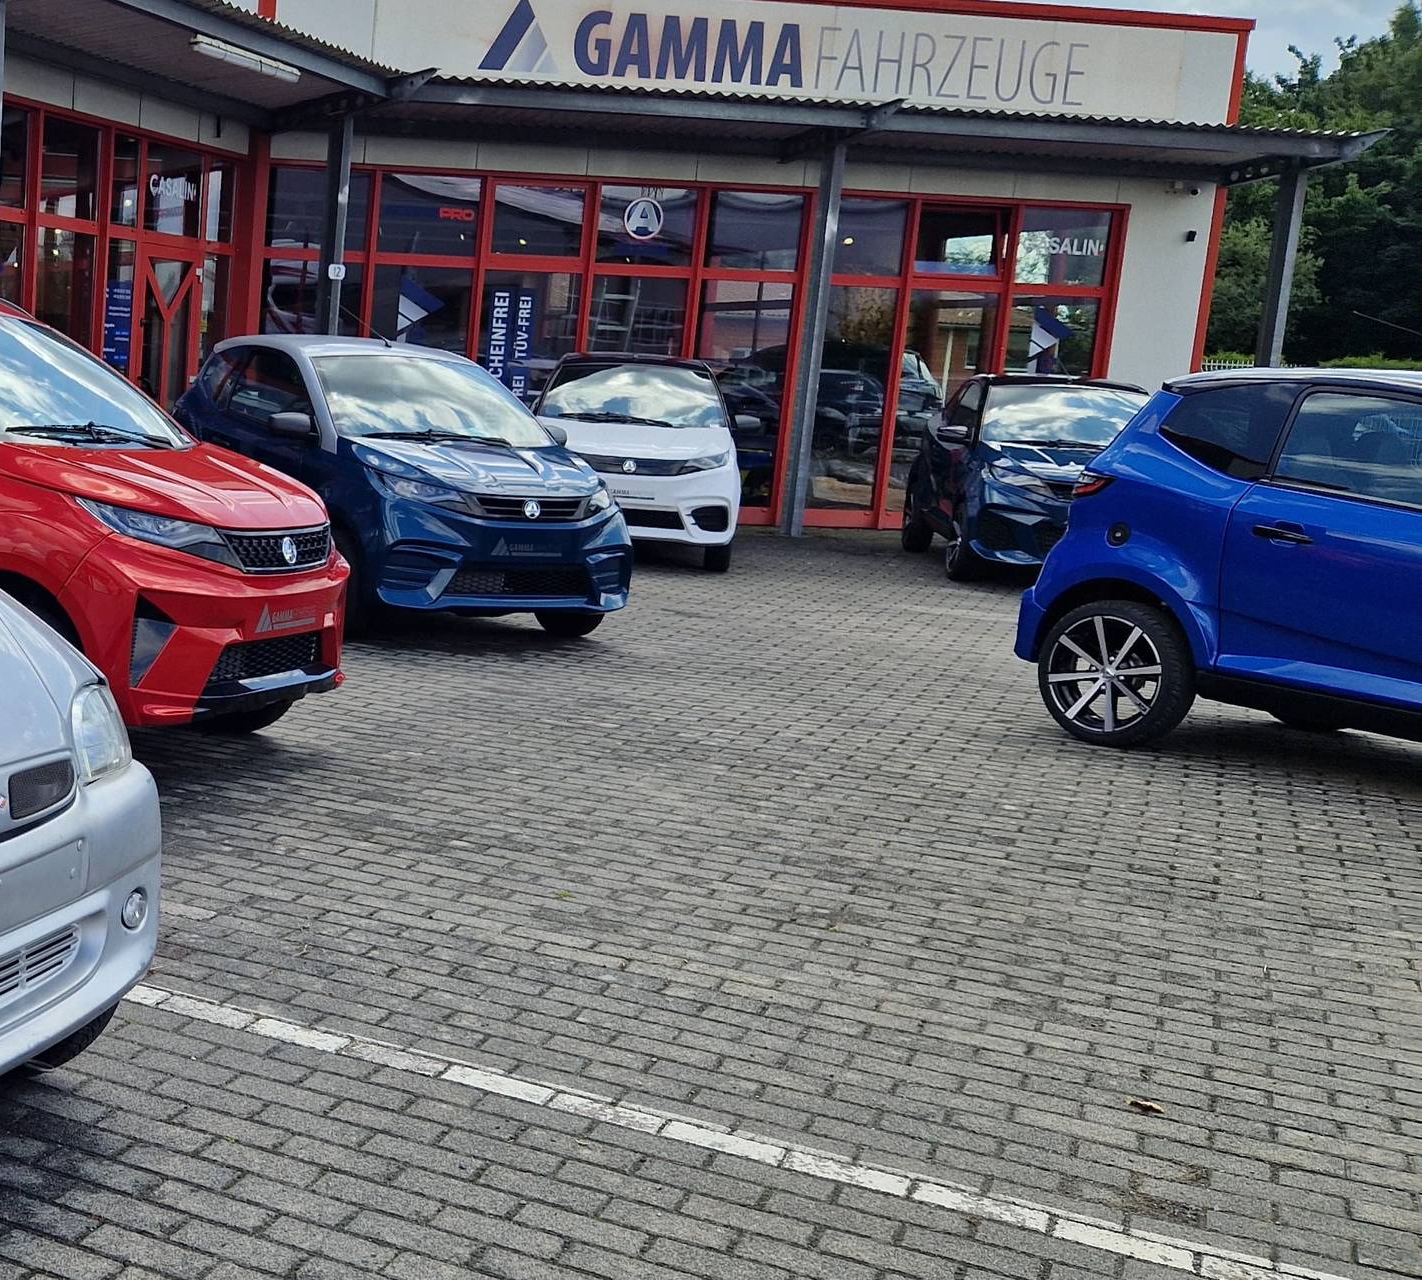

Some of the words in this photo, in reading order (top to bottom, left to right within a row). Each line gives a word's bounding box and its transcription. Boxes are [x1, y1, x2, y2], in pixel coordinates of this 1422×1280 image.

[574, 10, 803, 89] GAMMA
[813, 26, 1090, 106] FAHRZEUGE
[439, 207, 475, 221] PRO
[513, 296, 532, 359] TÜV-FREI
